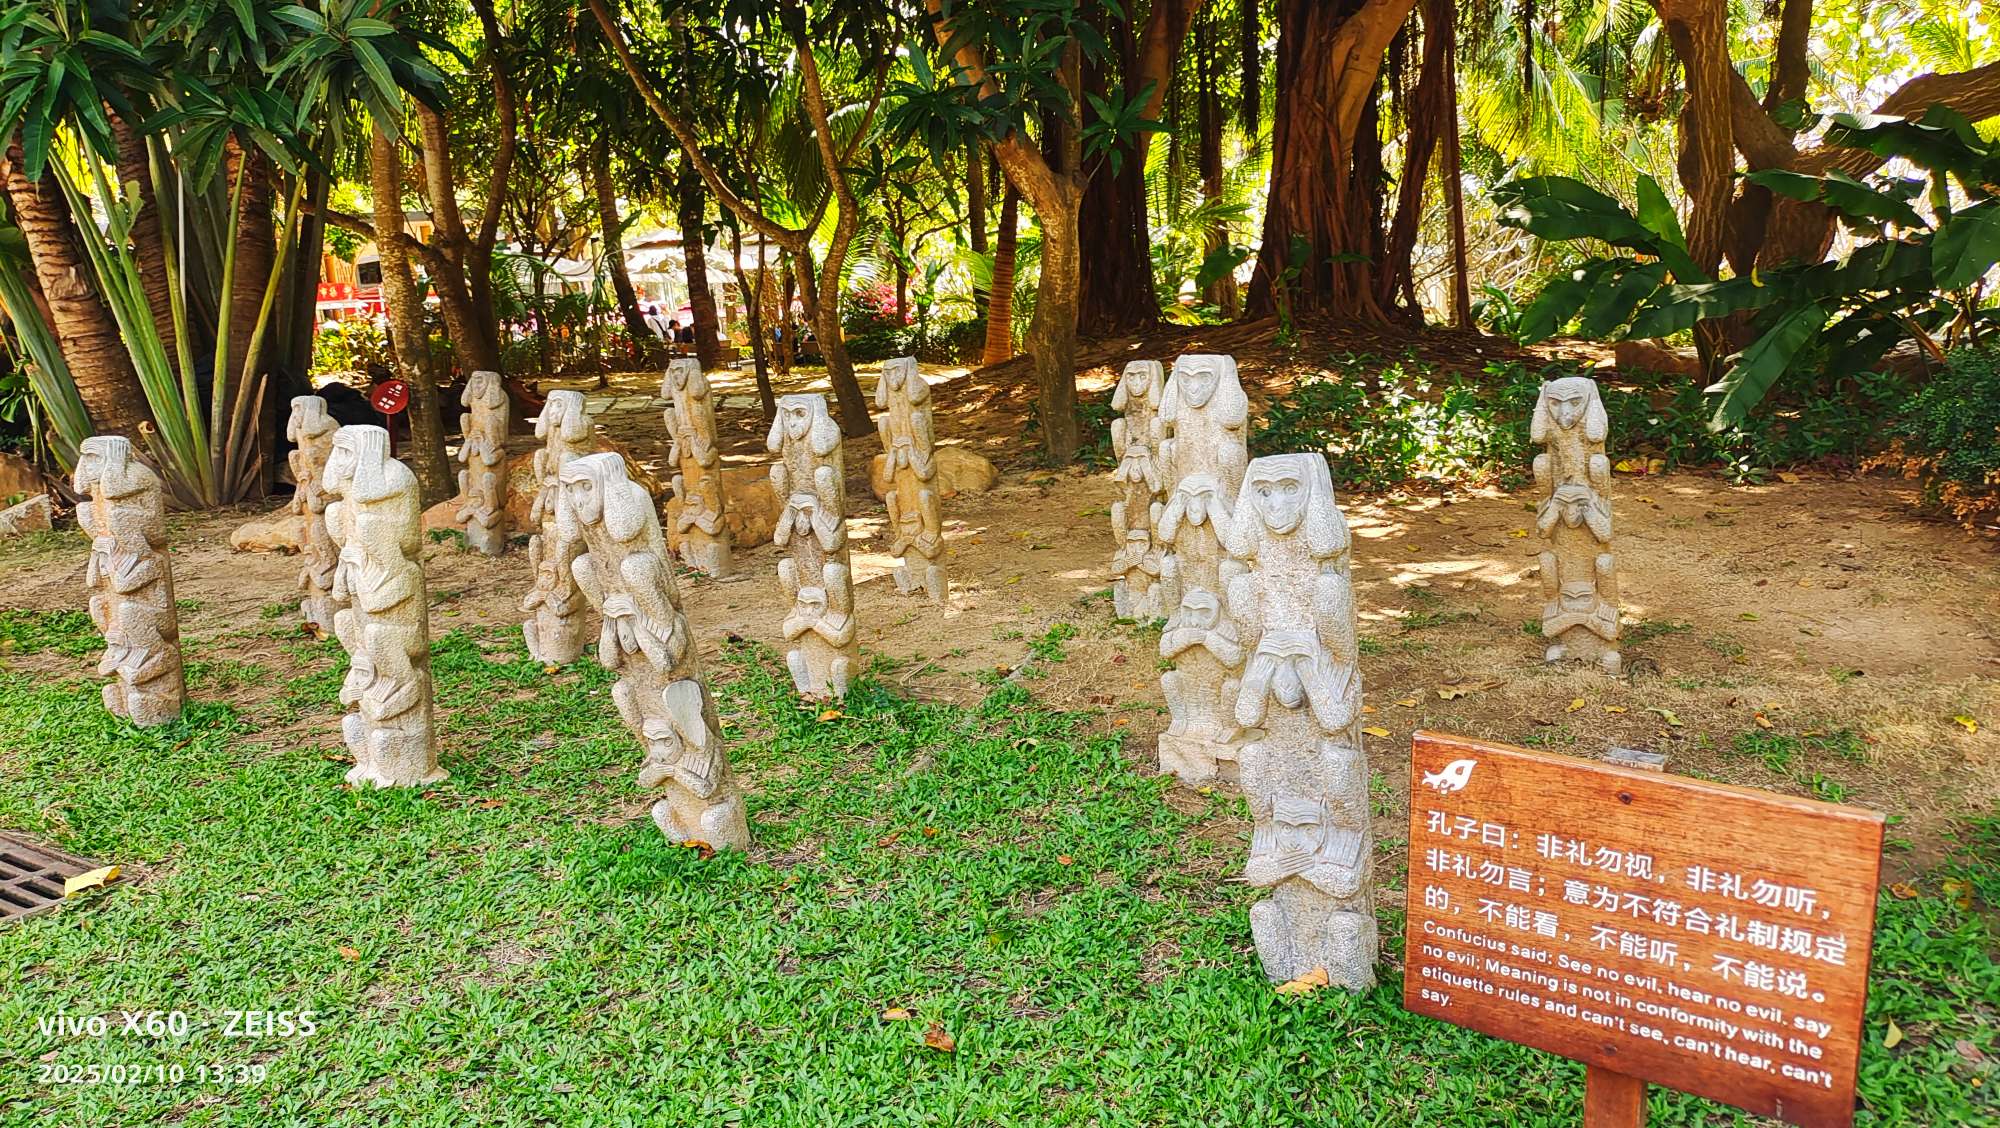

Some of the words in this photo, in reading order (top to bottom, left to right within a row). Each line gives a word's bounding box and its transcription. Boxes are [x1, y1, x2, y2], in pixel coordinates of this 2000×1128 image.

[1421, 986, 1453, 1007] say.
[1422, 965, 1494, 995] etiquette
[1498, 987, 1540, 1008] rules
[1544, 1002, 1577, 1018] and
[1581, 1010, 1626, 1032] can't
[1673, 1034, 1722, 1059] can't
[1781, 1063, 1833, 1089] can't
[1423, 920, 1506, 952] Confucius
[1511, 943, 1553, 965] said:
[1557, 954, 1592, 974] See
[1597, 966, 1619, 981] no
[1668, 981, 1712, 1005] hear
[1715, 995, 1741, 1013] no
[1793, 1015, 1832, 1039] say
[1423, 944, 1443, 958] no
[1446, 951, 1481, 970] evil;
[1485, 958, 1559, 992] Meaning
[1563, 978, 1578, 995] is
[1582, 985, 1612, 1005] not
[1615, 990, 1631, 1008] in
[1636, 998, 1739, 1040] conformity
[1742, 1027, 1784, 1050] with
[1788, 1037, 1823, 1060] the
